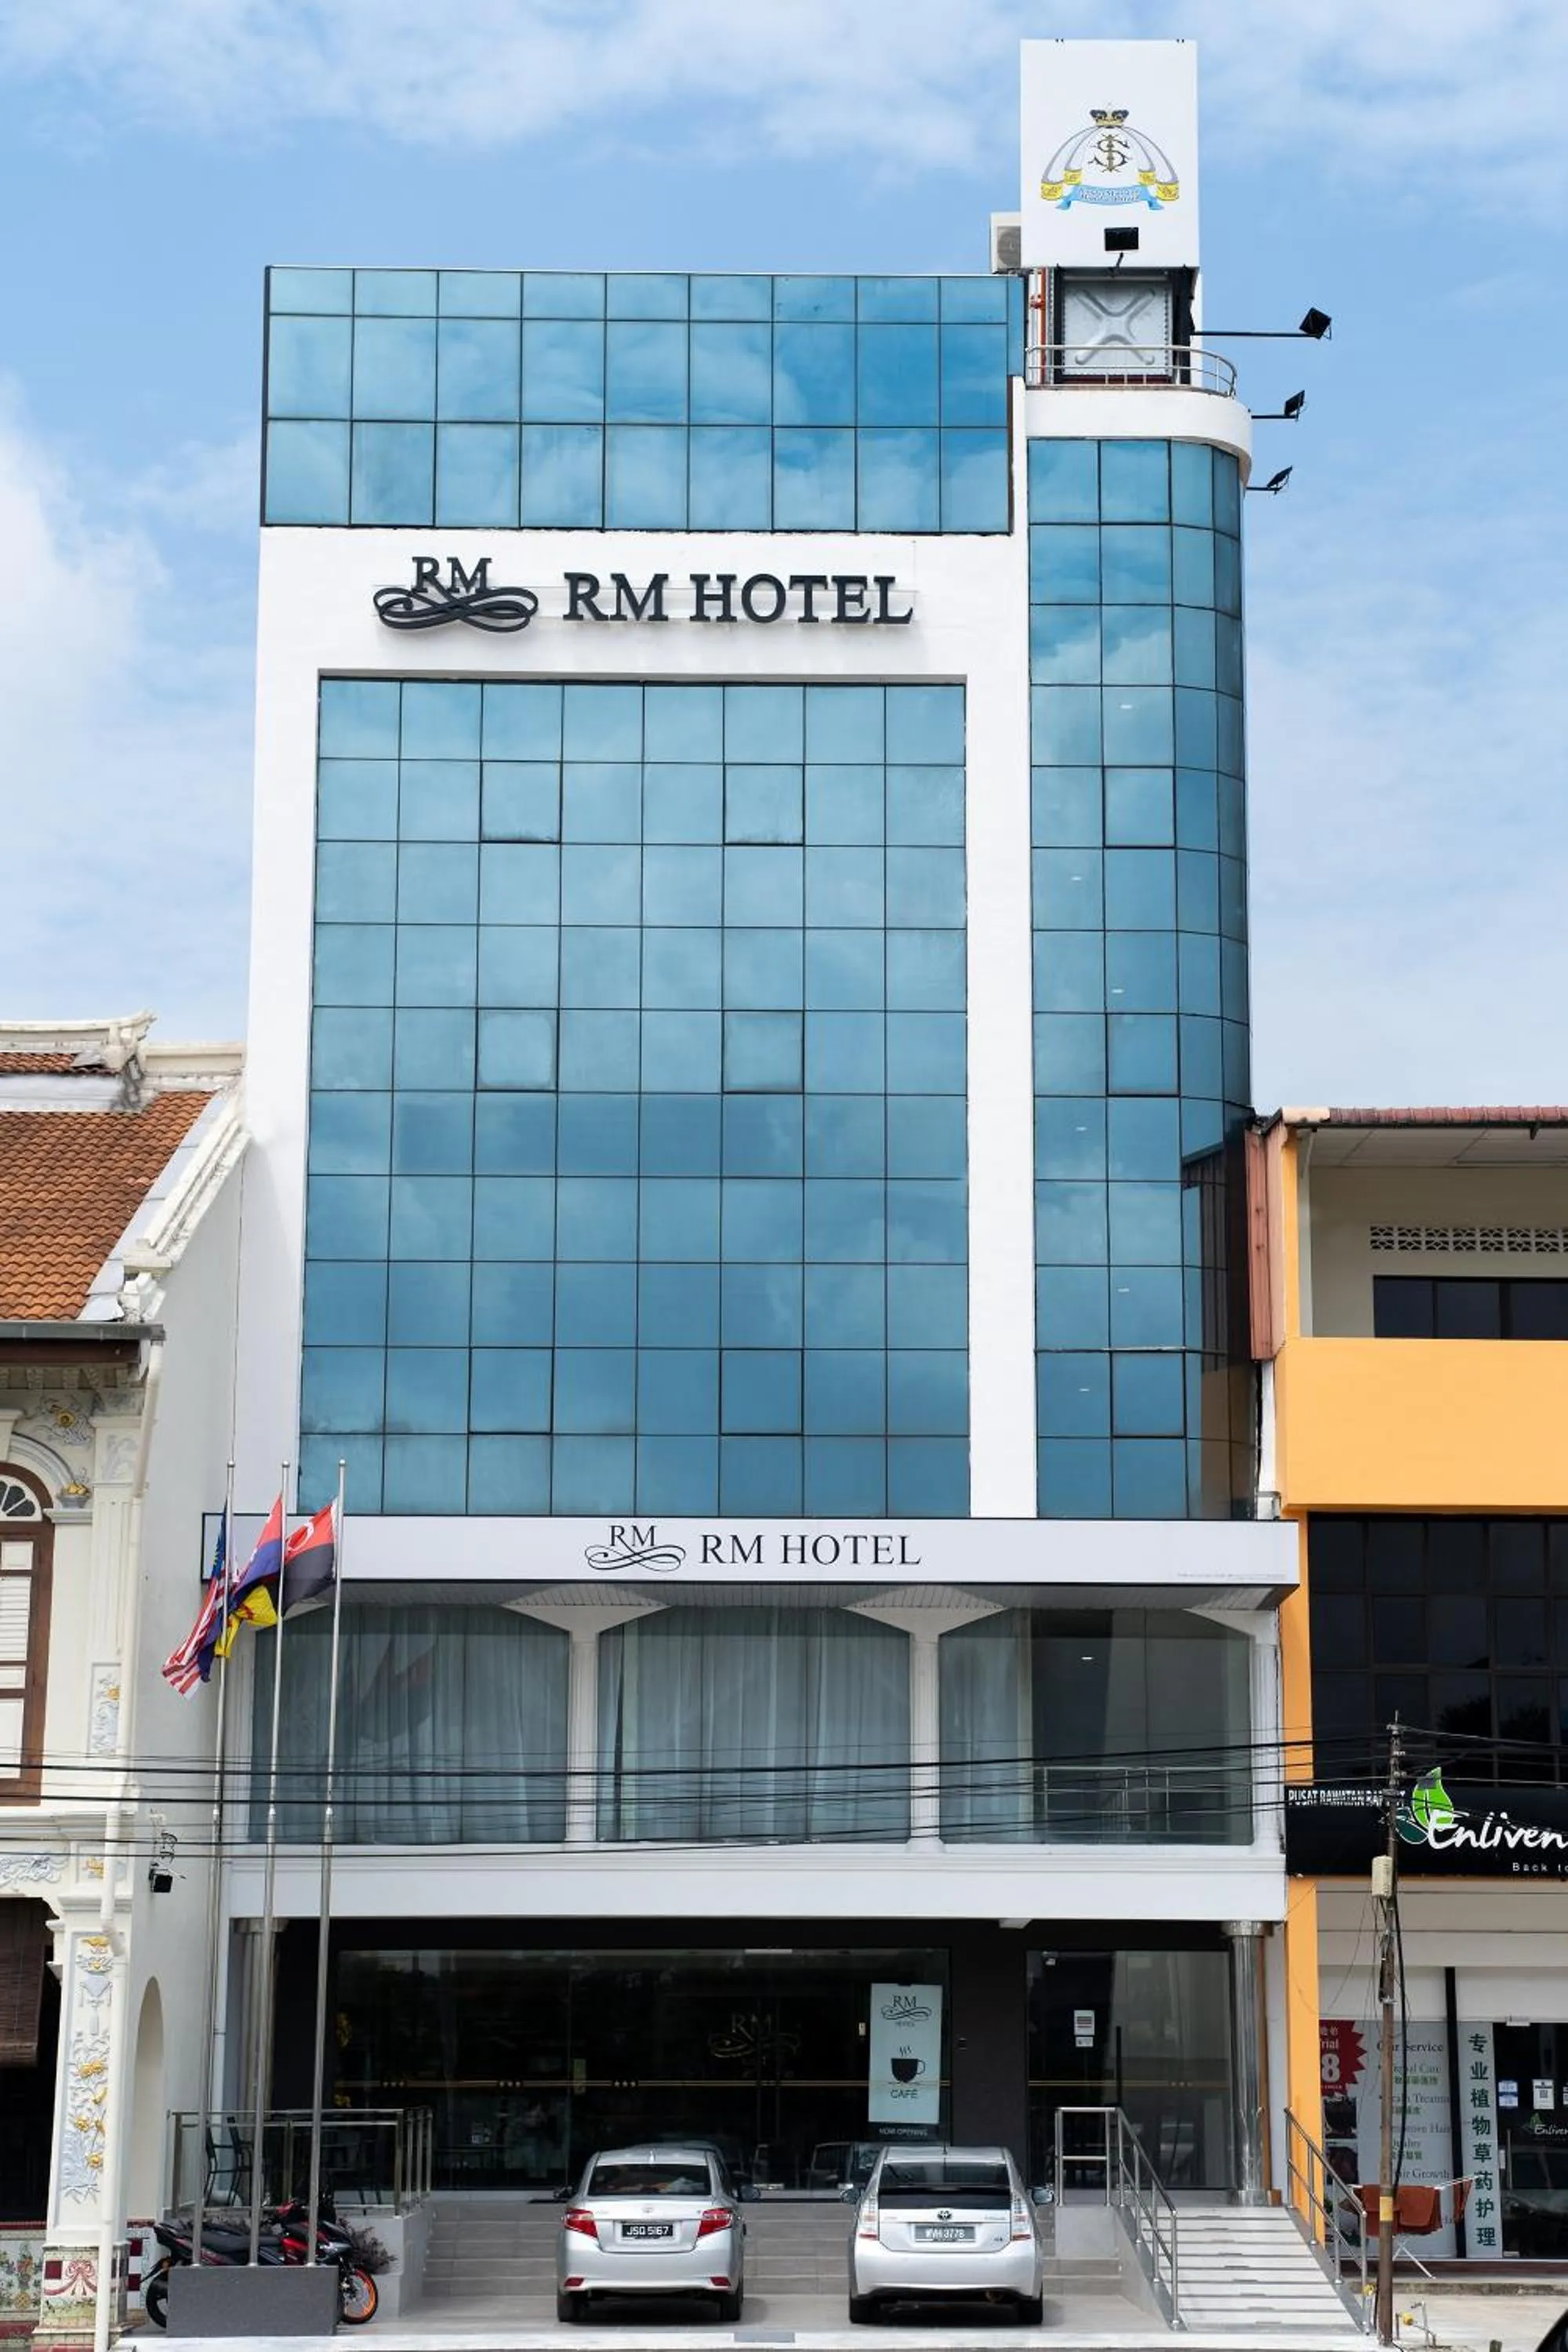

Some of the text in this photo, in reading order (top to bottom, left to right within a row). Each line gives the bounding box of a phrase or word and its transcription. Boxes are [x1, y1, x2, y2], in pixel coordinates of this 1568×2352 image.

[412, 557, 492, 593] RM
[564, 572, 913, 624] RM HOTEL
[609, 1525, 658, 1547] RM
[701, 1534, 921, 1565] RM HOTEL
[1288, 1790, 1317, 1806] PUSAT
[1428, 1809, 1568, 1849] Enliven
[1512, 1862, 1548, 1871] Back
[892, 1994, 916, 2008] RM
[1468, 2033, 1497, 2246] 专业植物草药护理
